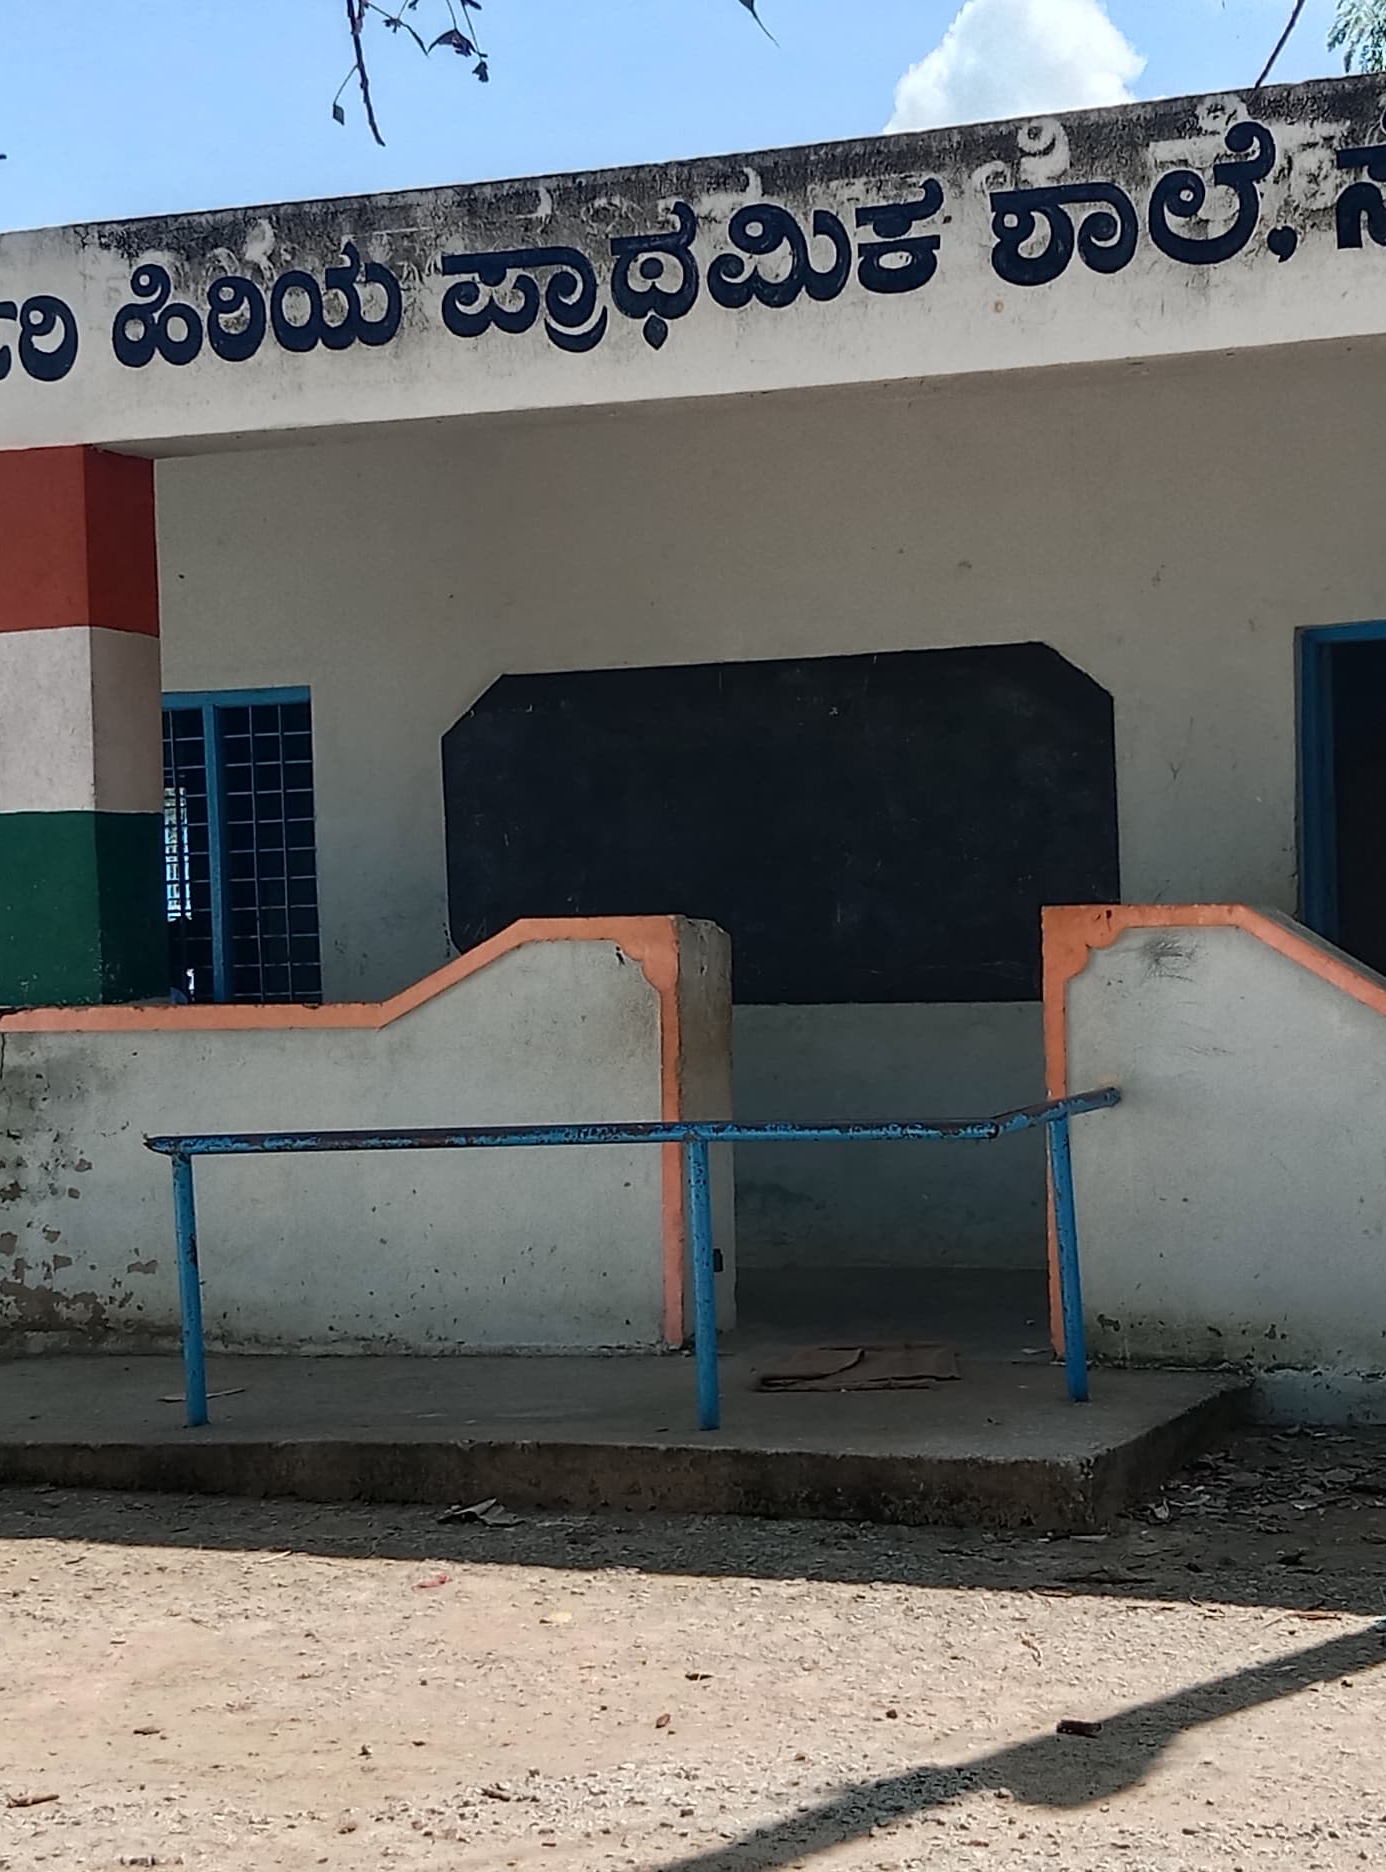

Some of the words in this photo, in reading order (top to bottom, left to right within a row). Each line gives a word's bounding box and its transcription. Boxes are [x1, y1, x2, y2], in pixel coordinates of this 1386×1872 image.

[112, 241, 403, 368] ಹಿರಿಯ
[441, 178, 943, 352] ಪ್ರಾಥಮಿಕ
[990, 121, 1298, 286] ಶಾಲೆ,
